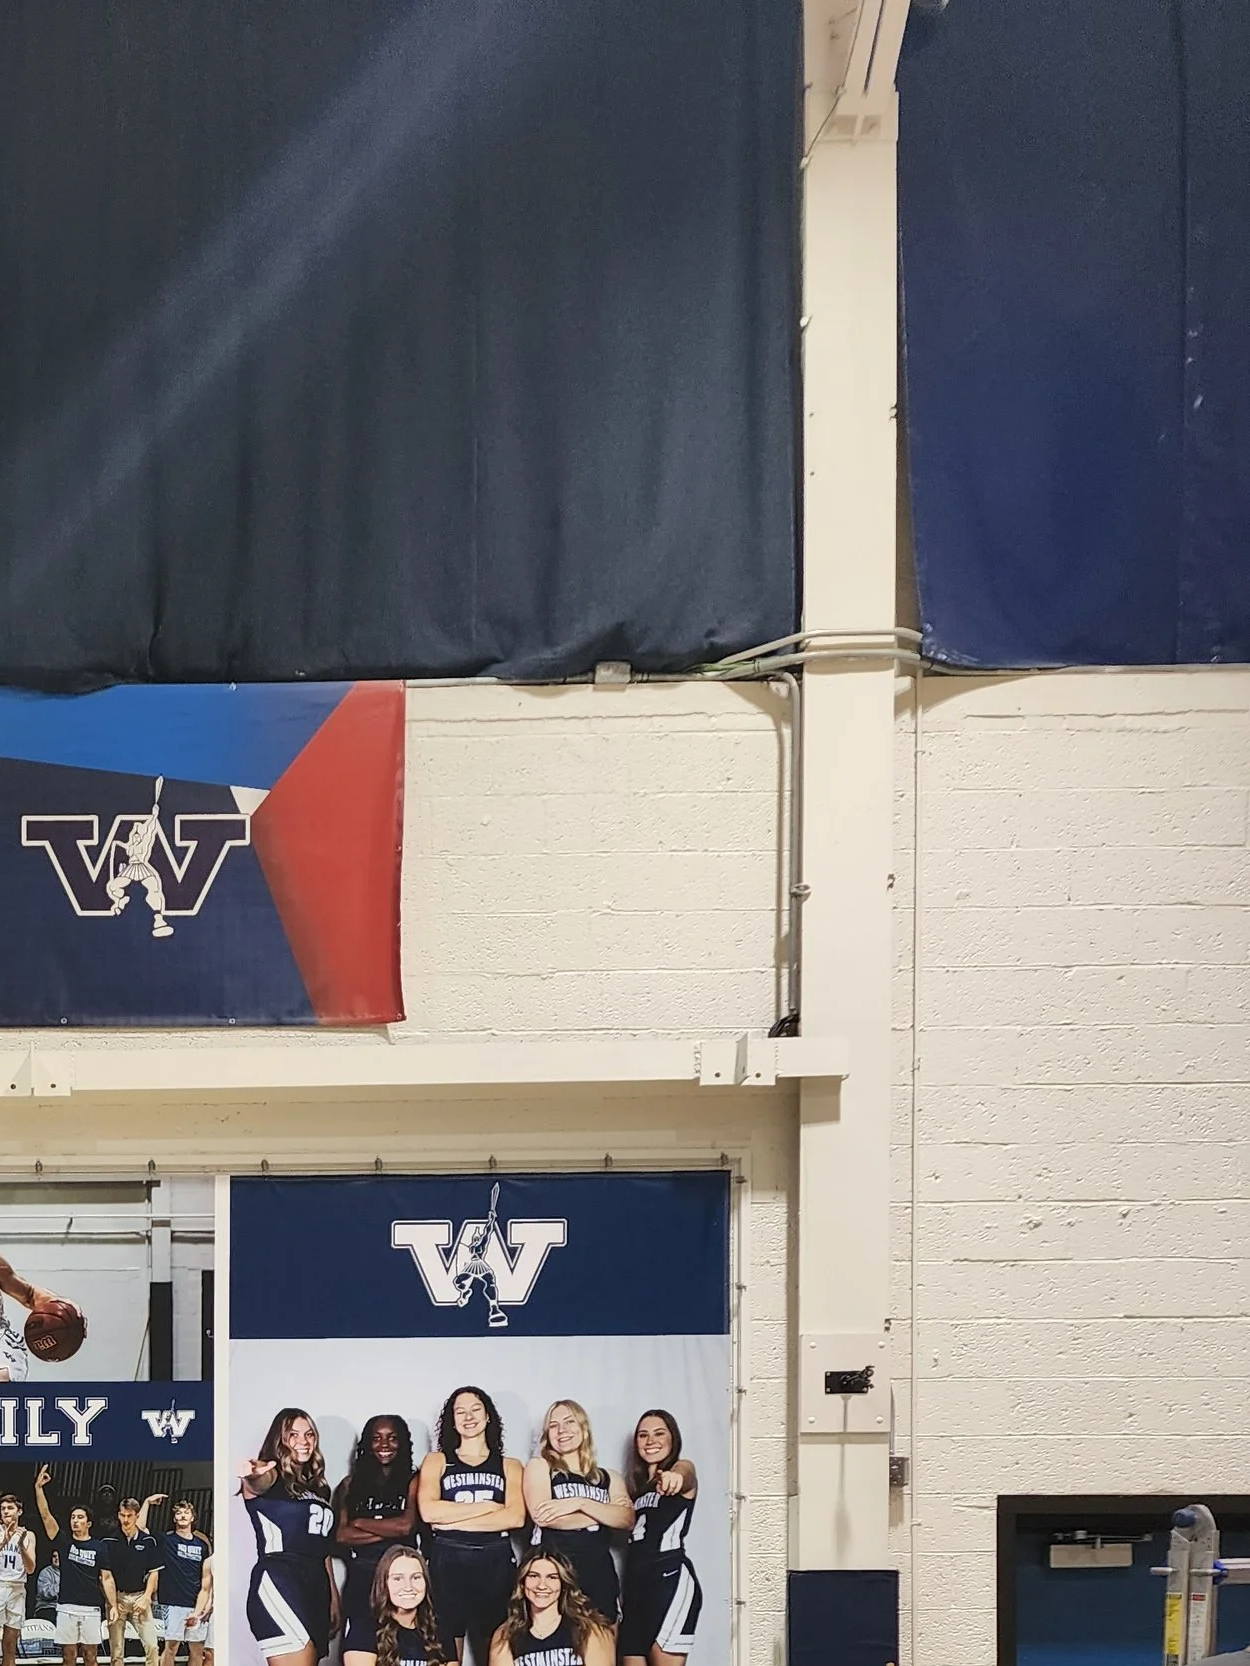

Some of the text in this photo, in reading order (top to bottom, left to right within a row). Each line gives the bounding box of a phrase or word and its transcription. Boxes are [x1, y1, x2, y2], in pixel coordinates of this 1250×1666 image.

[21, 814, 251, 917] W
[391, 1219, 567, 1306] W
[141, 1409, 196, 1437] W
[4, 1555, 17, 1569] 14
